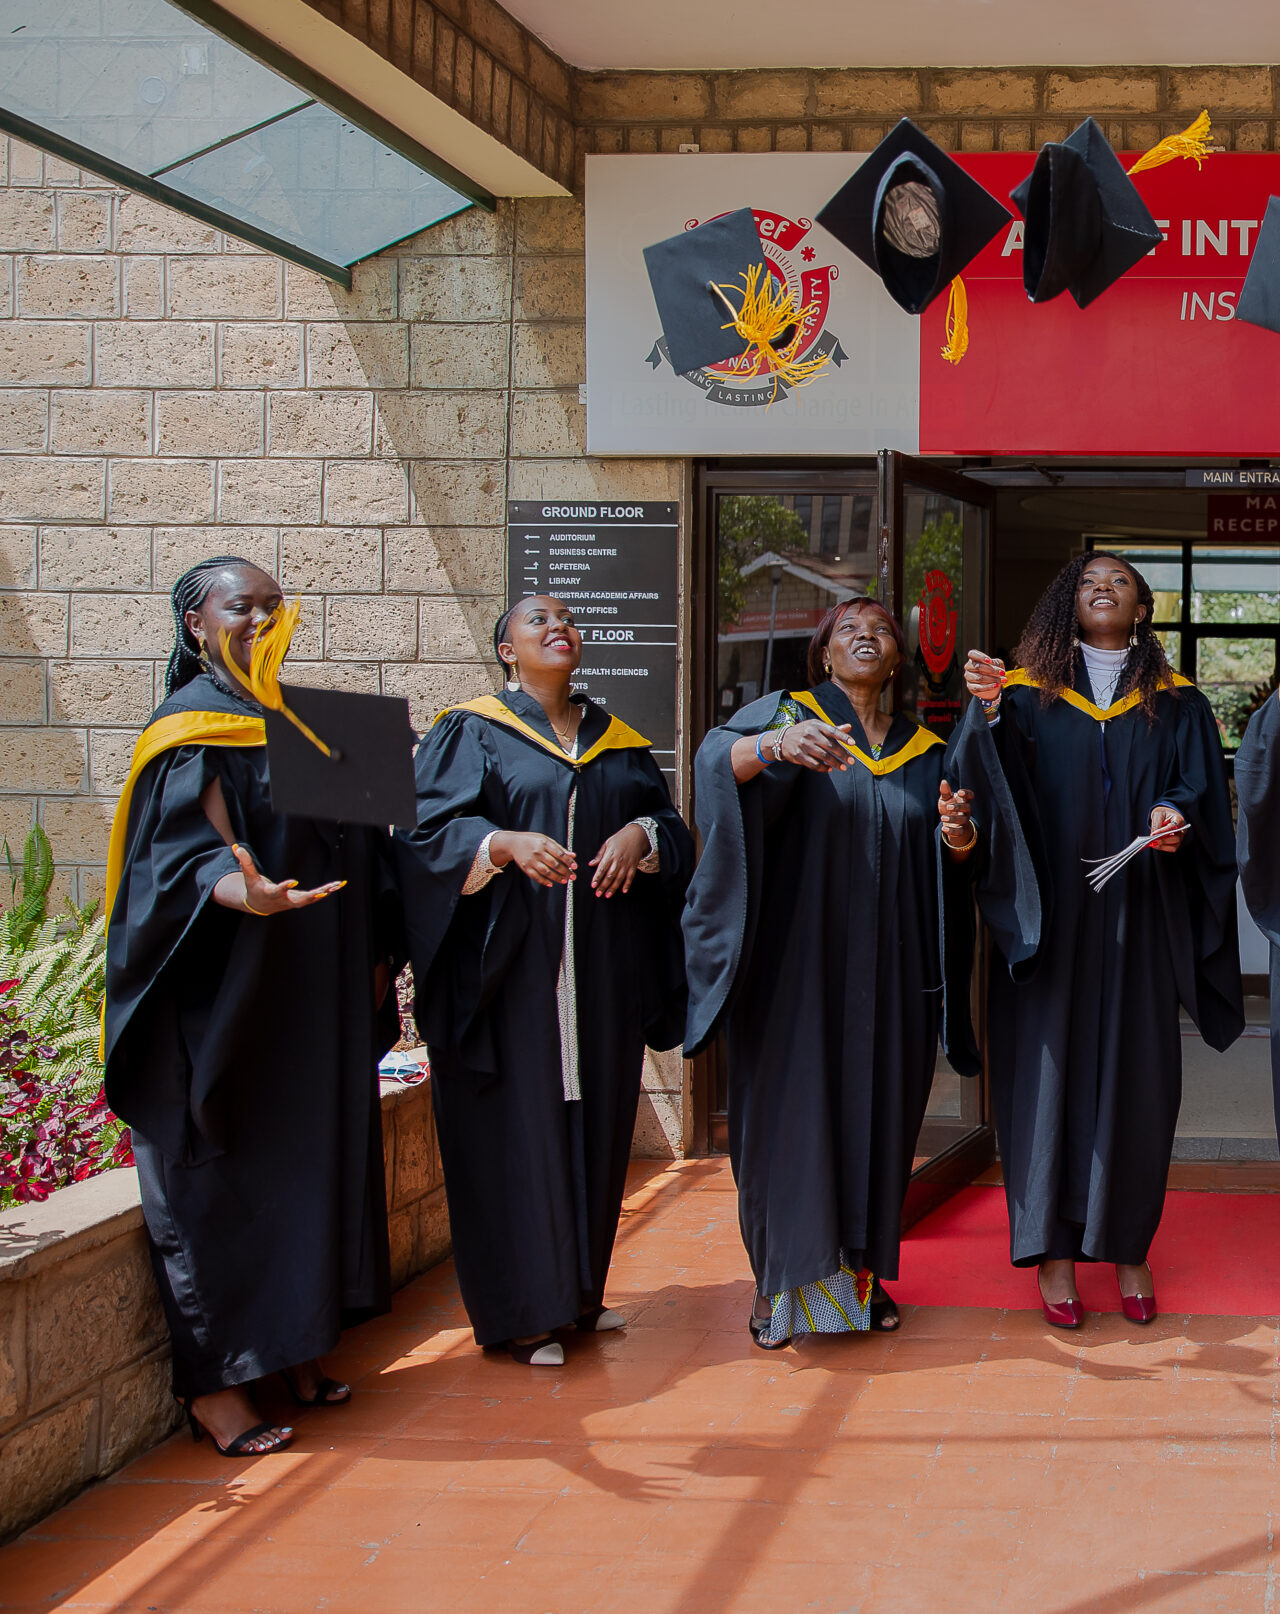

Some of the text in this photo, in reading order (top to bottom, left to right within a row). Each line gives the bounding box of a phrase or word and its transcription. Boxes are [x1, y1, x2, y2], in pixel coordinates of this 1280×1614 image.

[718, 391, 774, 402] LASTING
[1203, 472, 1234, 483] MAIN
[541, 506, 644, 518] GROUND FLOOR
[549, 534, 596, 542] AUDITORIUM
[549, 548, 617, 556] BUSINESS CENTRE
[549, 563, 591, 571] CAFETERIA
[549, 577, 581, 585] LIBRARY
[629, 592, 659, 600] AFFAIRS
[586, 606, 618, 614] OFFICES
[592, 630, 635, 641] FLOOR
[611, 668, 649, 676] SCIENCES
